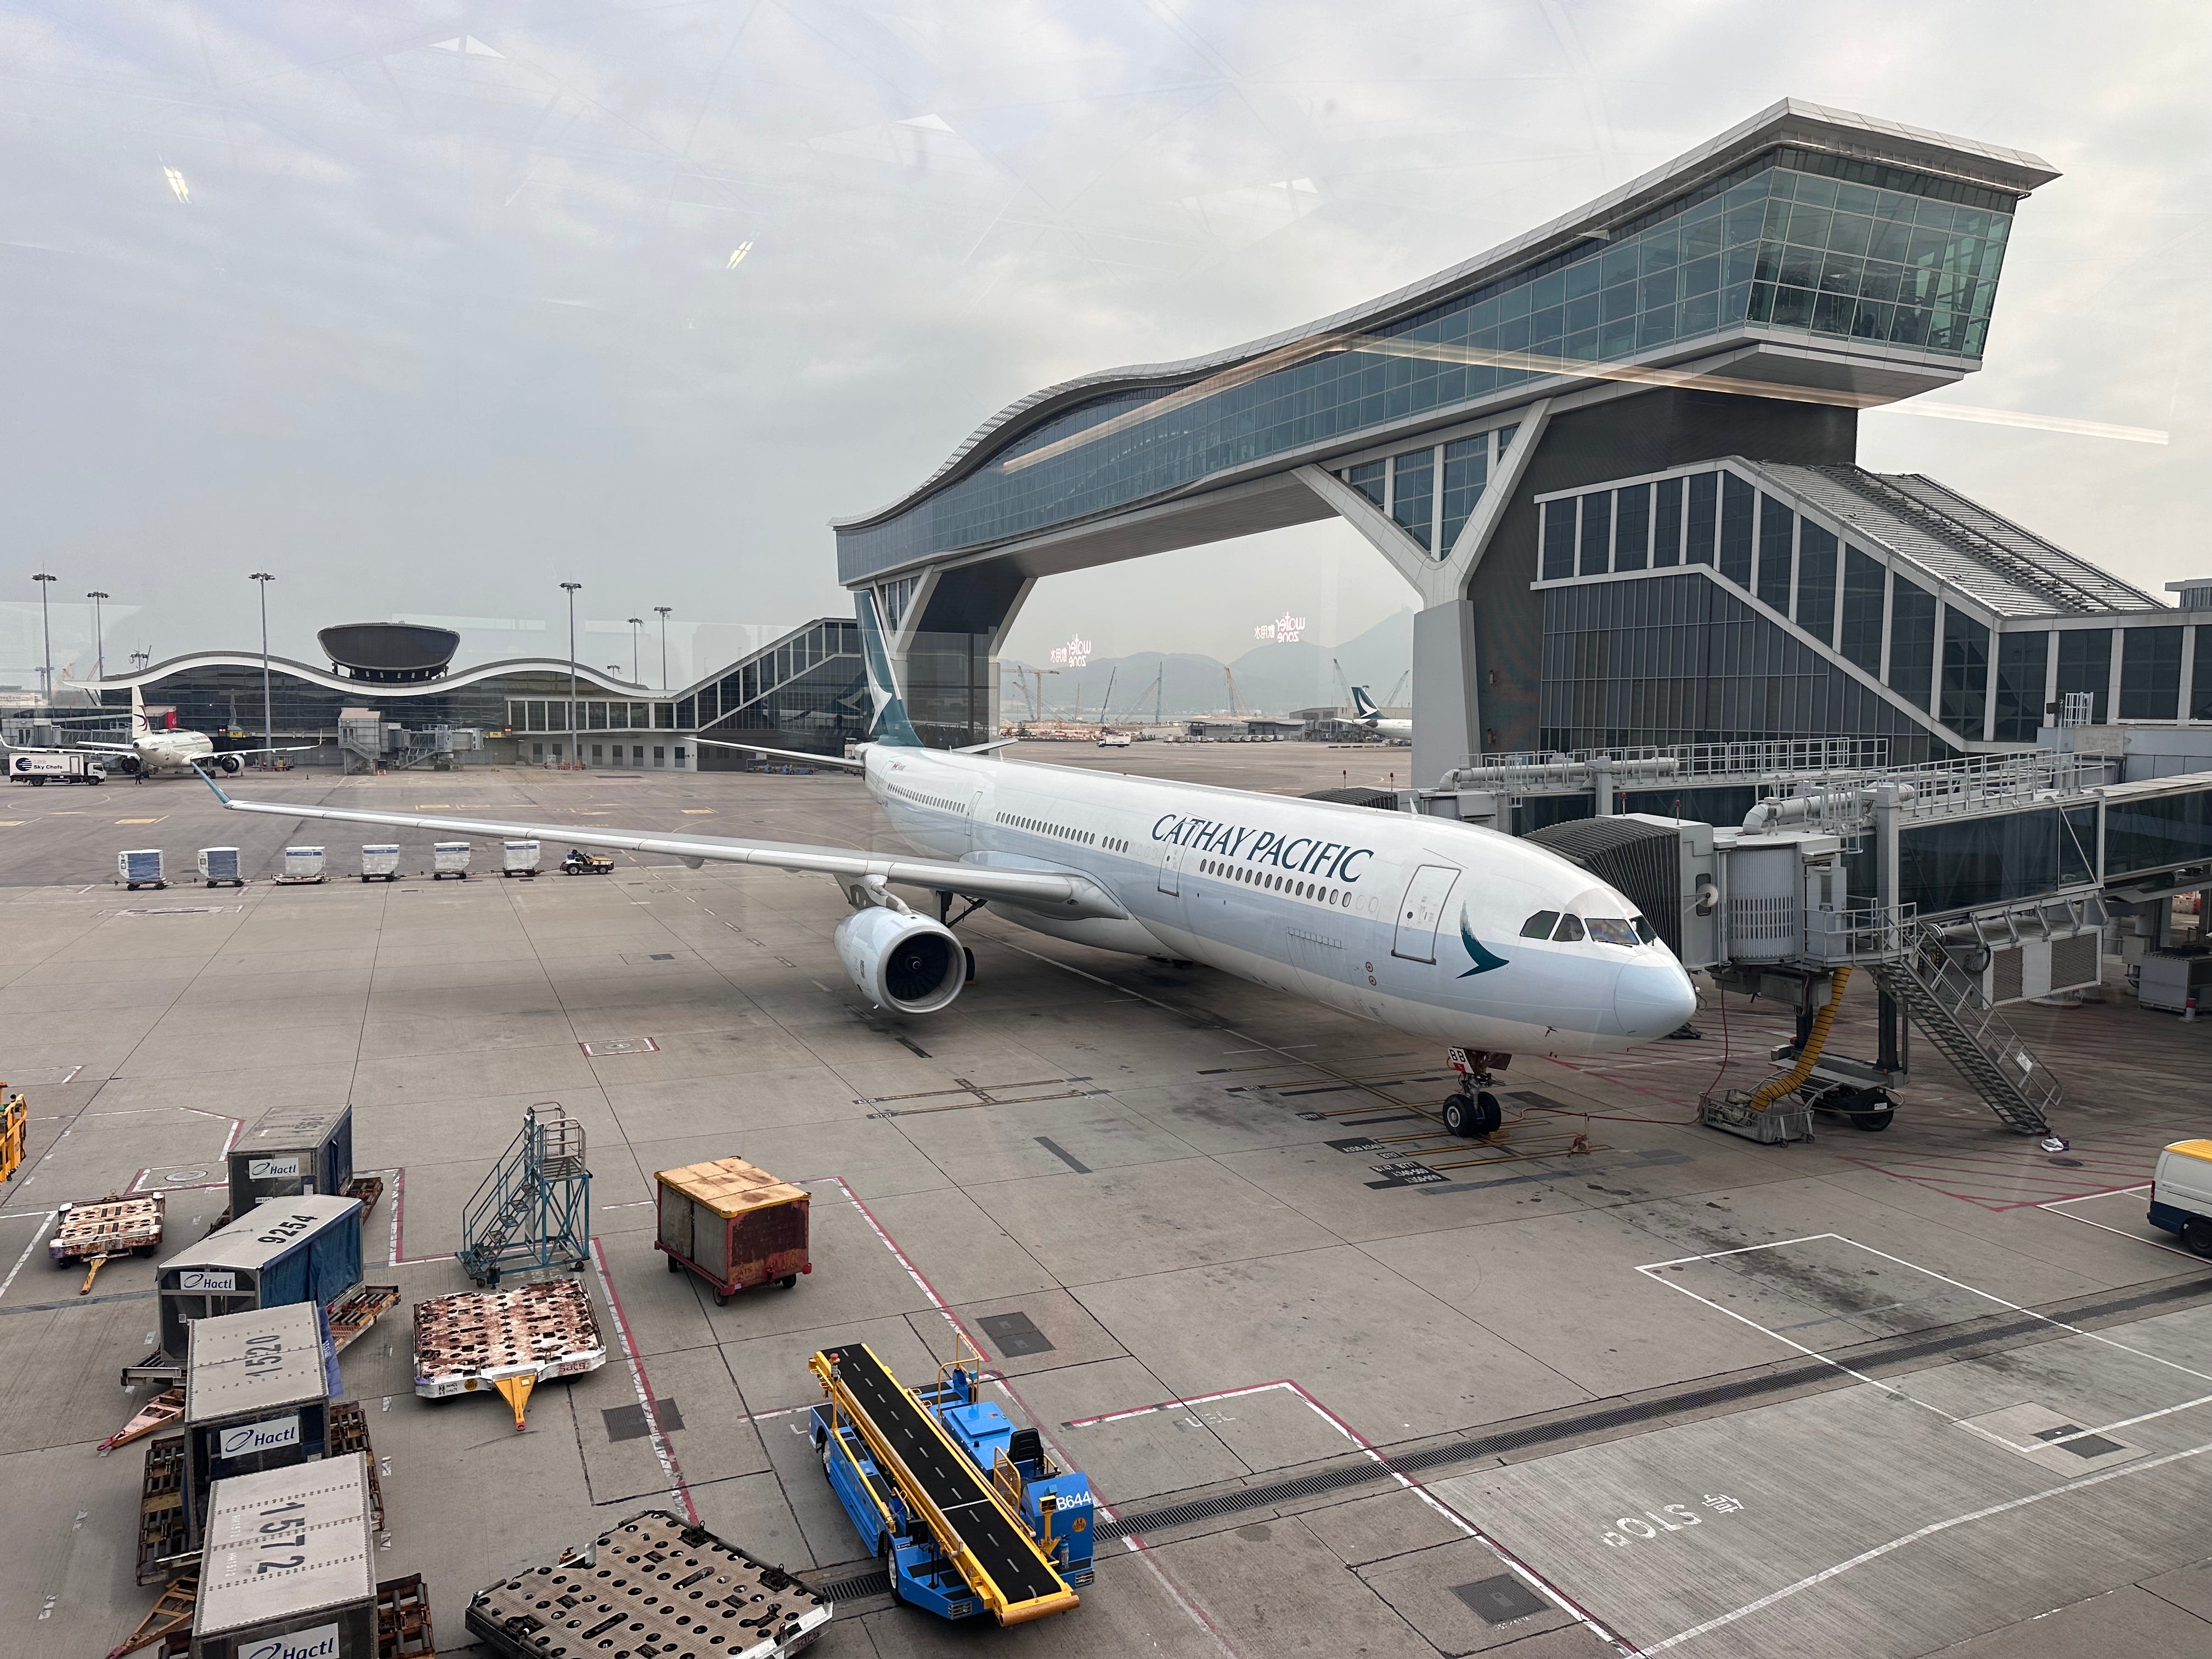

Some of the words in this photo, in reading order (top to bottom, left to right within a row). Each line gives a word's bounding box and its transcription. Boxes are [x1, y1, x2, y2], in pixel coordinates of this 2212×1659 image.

[1152, 814, 1257, 857] CATHAY
[1246, 831, 1375, 883] PACIFIC
[1449, 1049, 1466, 1063] BB
[270, 1164, 296, 1174] Hactl
[257, 1215, 318, 1244] 9254
[204, 1279, 232, 1289] Hactl
[245, 1335, 283, 1376] 1520
[255, 1426, 295, 1446] Hactl
[1056, 1491, 1092, 1511] B644
[1701, 1493, 1745, 1514] 停
[230, 1515, 241, 1538] HH1572
[257, 1502, 305, 1575] 1572
[225, 1552, 237, 1578] HH1572
[283, 1637, 334, 1659] Hactl
